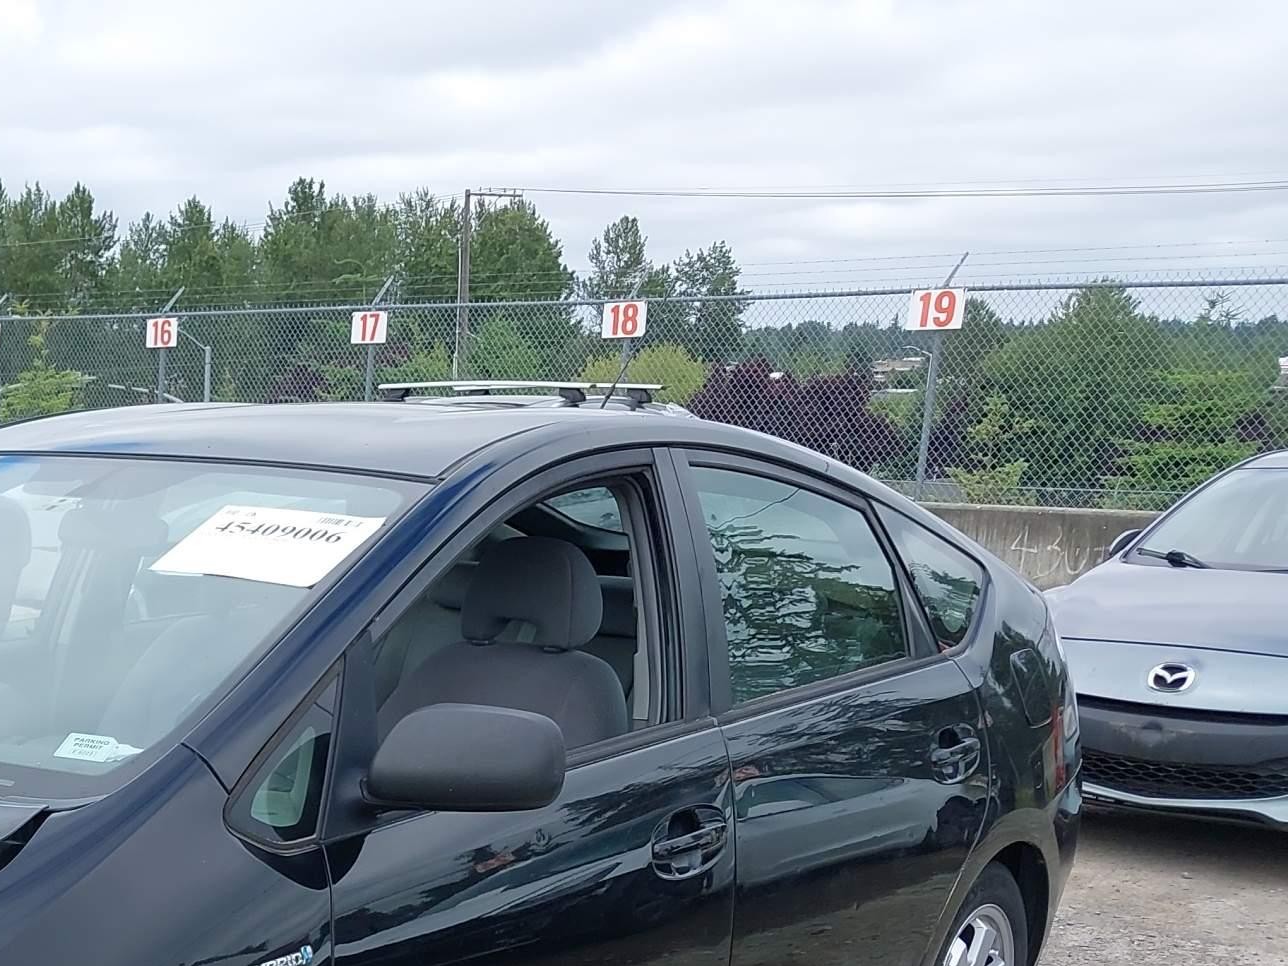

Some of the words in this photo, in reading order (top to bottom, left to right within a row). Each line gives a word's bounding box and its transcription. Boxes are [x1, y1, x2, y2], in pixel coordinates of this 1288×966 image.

[610, 303, 639, 336] 18
[919, 290, 957, 328] 19
[152, 318, 173, 346] 16
[359, 312, 382, 342] 17
[215, 521, 345, 544] 45409006
[73, 742, 104, 750] PERMIT
[74, 737, 111, 746] PARKING
